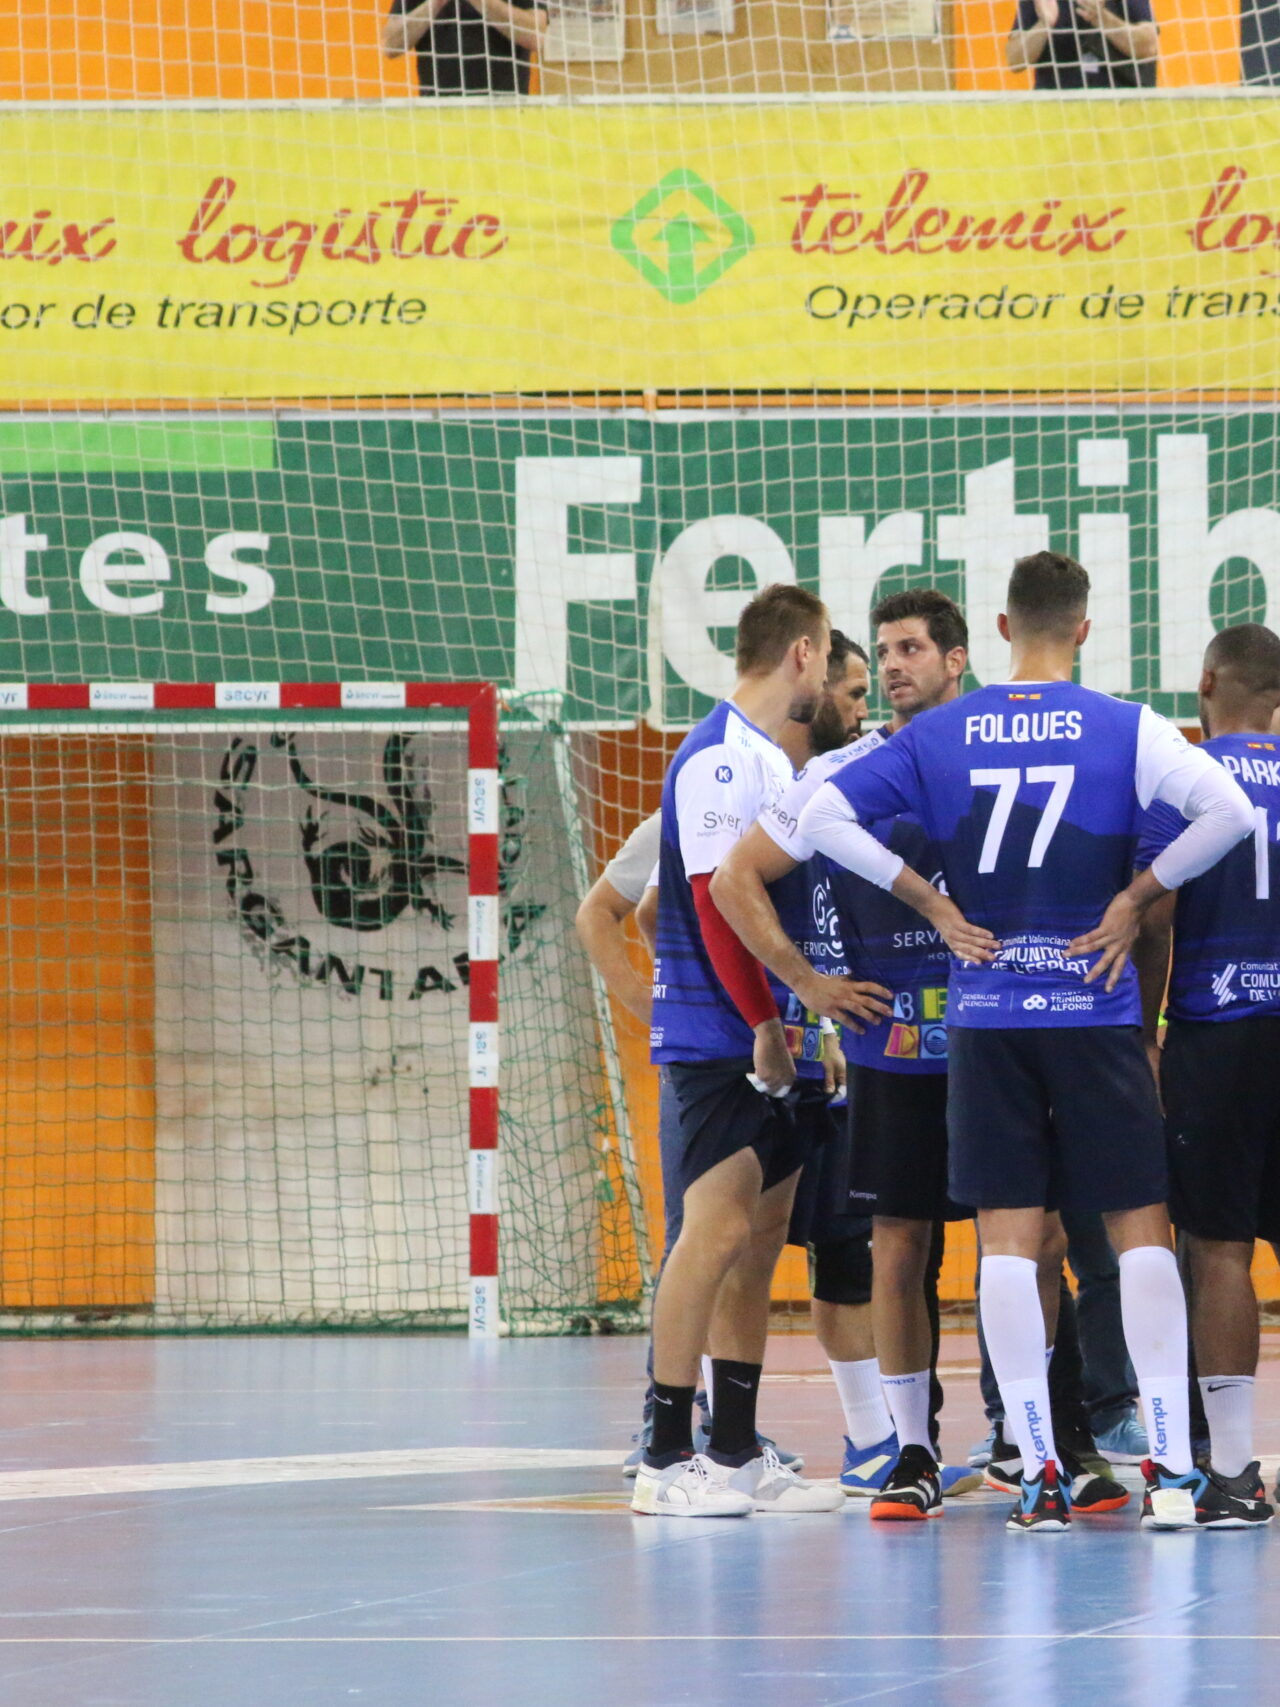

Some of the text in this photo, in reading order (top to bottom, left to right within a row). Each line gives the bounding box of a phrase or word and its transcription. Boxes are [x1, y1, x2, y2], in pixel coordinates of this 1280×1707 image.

[178, 177, 509, 288] logistic
[779, 168, 1127, 257] telemix
[73, 294, 136, 329] de
[156, 292, 427, 336] transporte
[805, 284, 1065, 328] Operador
[1081, 283, 1145, 319] de
[965, 711, 1082, 744] FOLQUES
[970, 765, 1075, 874] 77
[1050, 1003, 1093, 1012] ALFONSO
[1023, 1399, 1049, 1465] Kempa
[1151, 1397, 1169, 1456] Kempa
